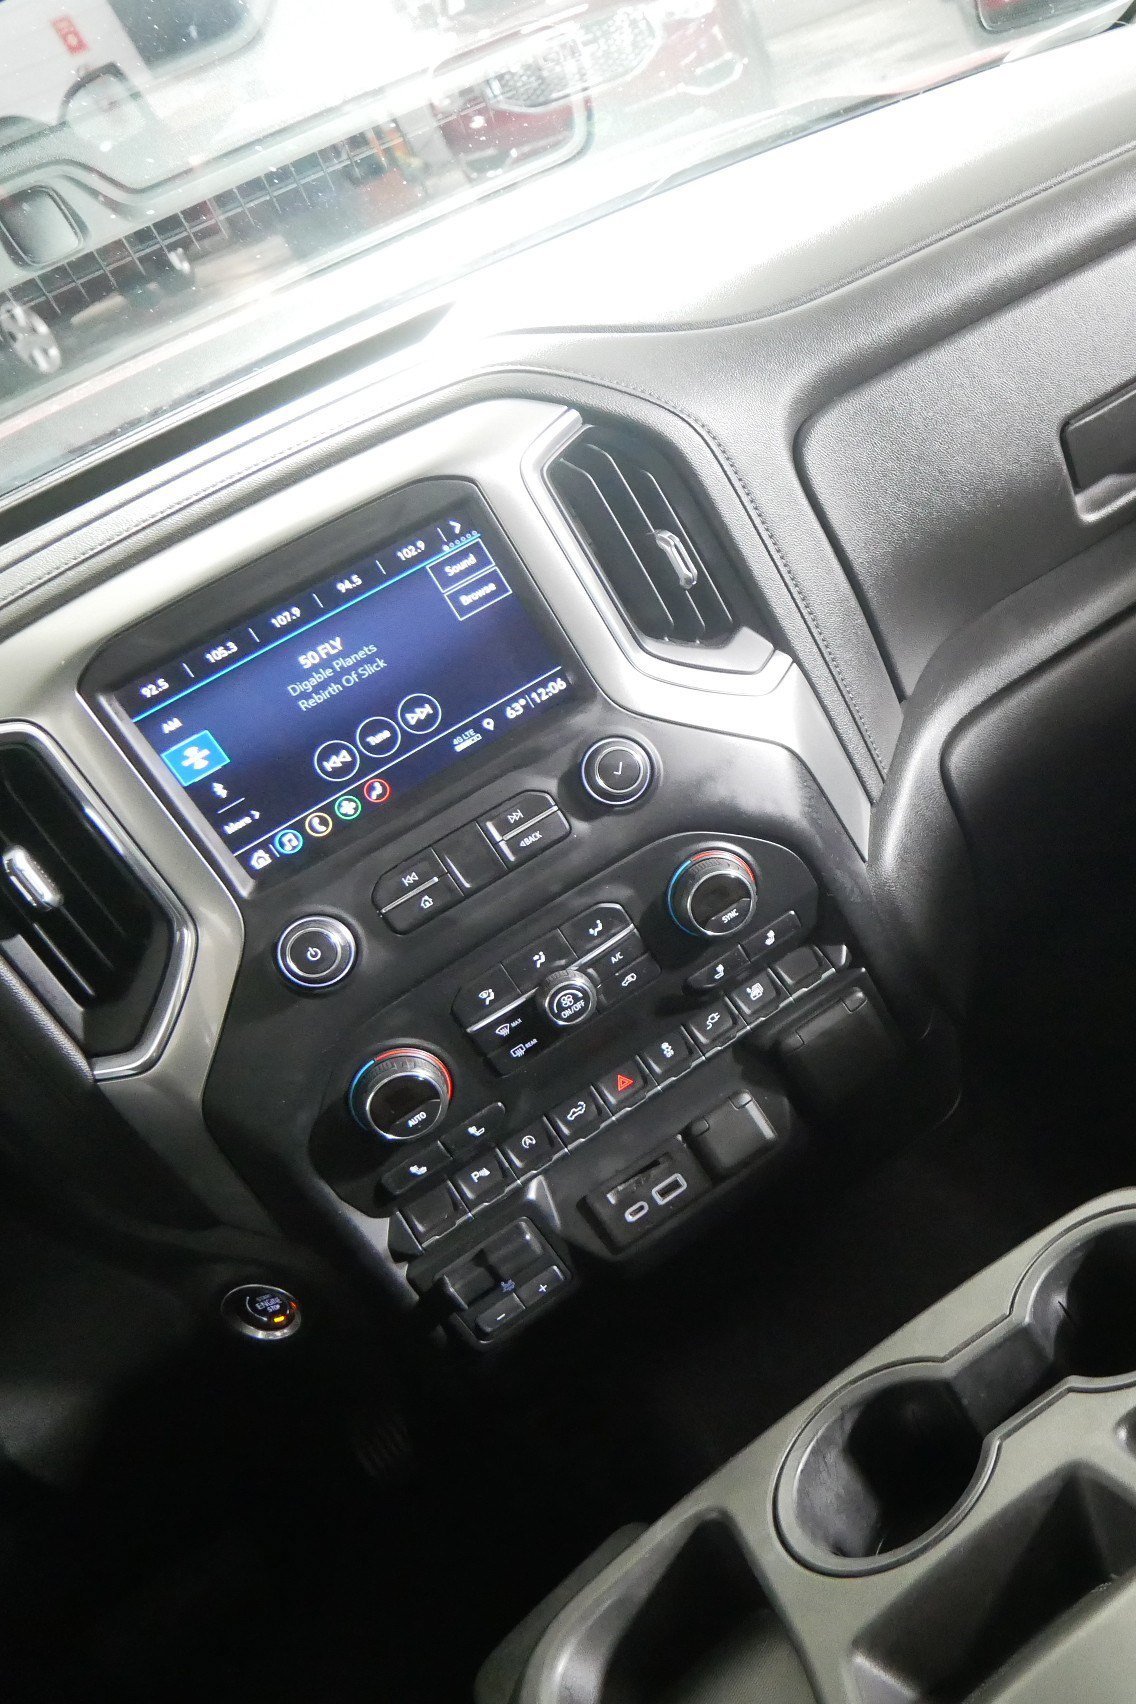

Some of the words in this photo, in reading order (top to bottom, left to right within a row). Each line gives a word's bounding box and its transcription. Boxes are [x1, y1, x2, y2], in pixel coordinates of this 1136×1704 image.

[397, 540, 426, 561] 102.9
[444, 552, 477, 577] Sound
[336, 574, 363, 593] 94.5
[459, 582, 497, 606] Browse
[270, 606, 301, 628] 107.9
[206, 641, 239, 663] 105.3
[317, 636, 343, 659] FLY
[287, 668, 335, 697] Digable
[332, 644, 378, 671] Planets
[140, 677, 170, 698] 92.5
[298, 682, 344, 711] Rebirth
[341, 671, 359, 687] Of
[358, 657, 388, 679] Slick
[530, 677, 567, 704] 12:06
[161, 717, 183, 734] AM
[463, 728, 476, 741] LTE
[525, 830, 543, 846] BACK
[721, 907, 740, 924] SYNC
[610, 951, 624, 965] A/C
[561, 999, 586, 1019] ON/OFF
[510, 1017, 523, 1028] MAX
[407, 1111, 428, 1128] AUTO
